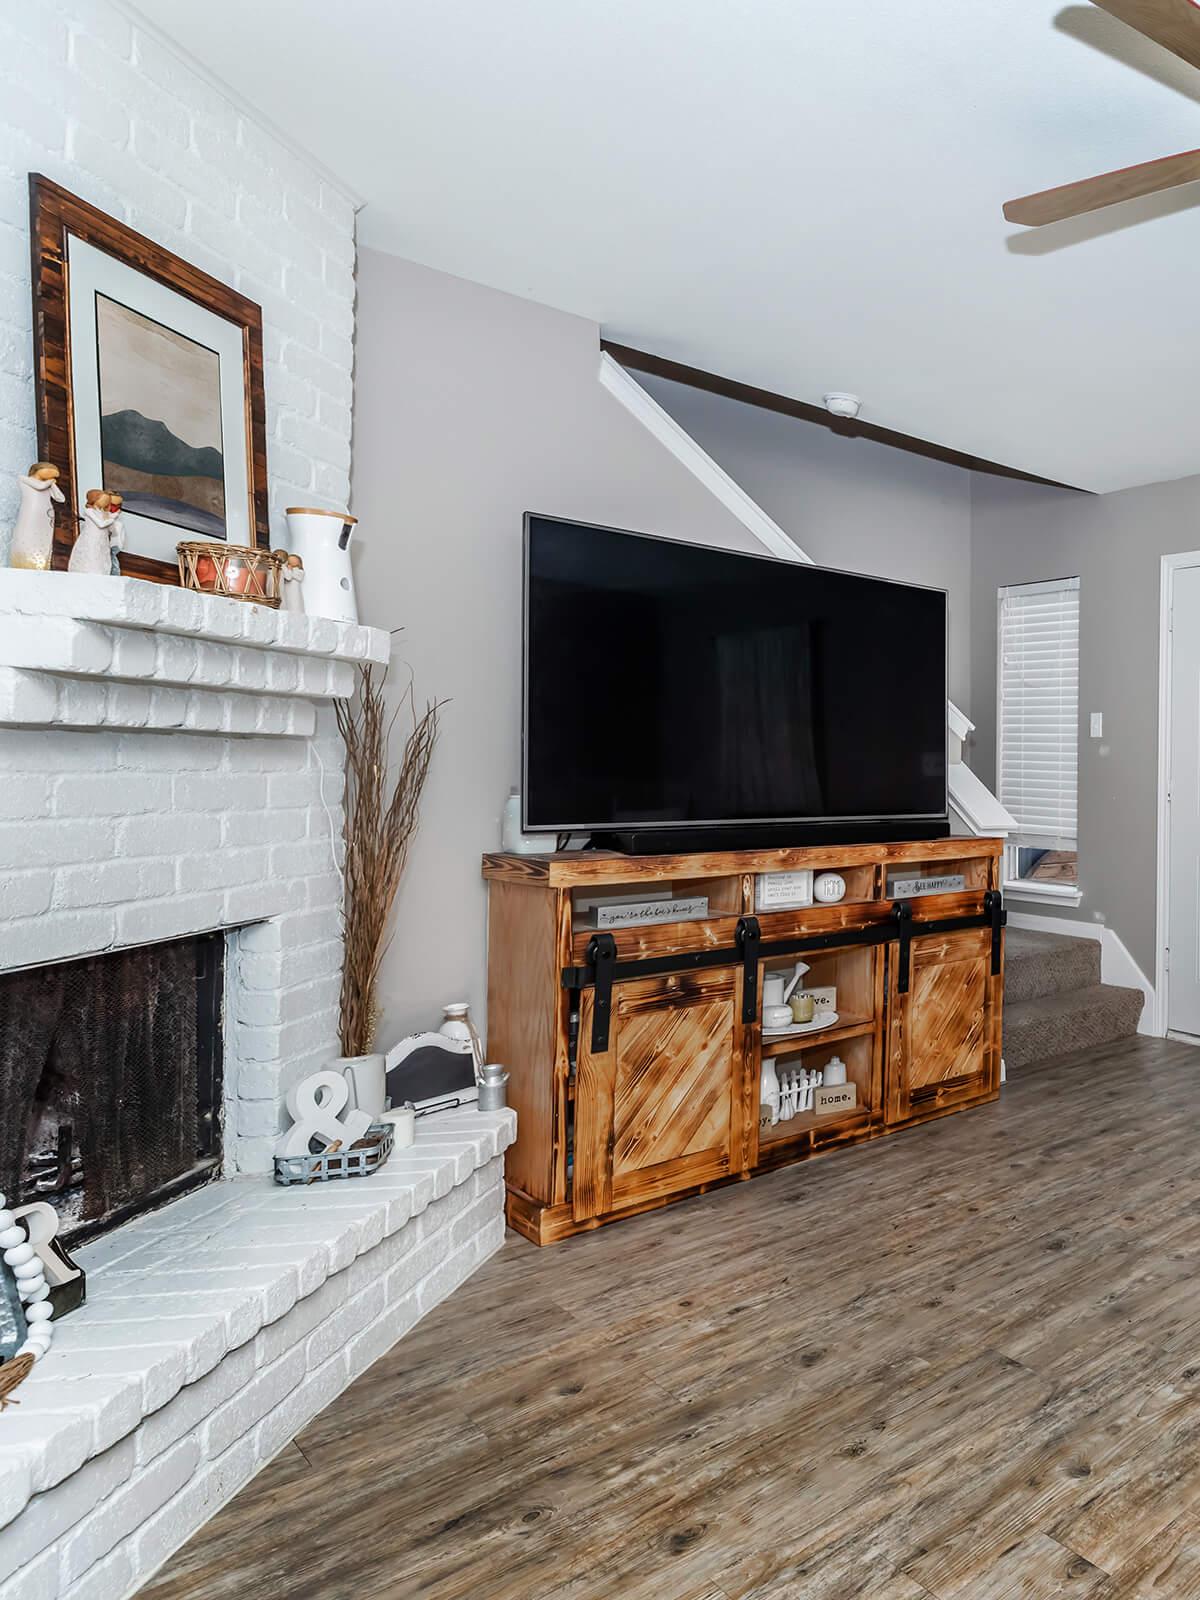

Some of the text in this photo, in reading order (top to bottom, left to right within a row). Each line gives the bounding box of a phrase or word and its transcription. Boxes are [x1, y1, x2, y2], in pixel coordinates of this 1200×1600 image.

[824, 880, 844, 896] HOME
[927, 880, 944, 889] HAPPY
[637, 905, 653, 917] the
[820, 1092, 851, 1105] home.
